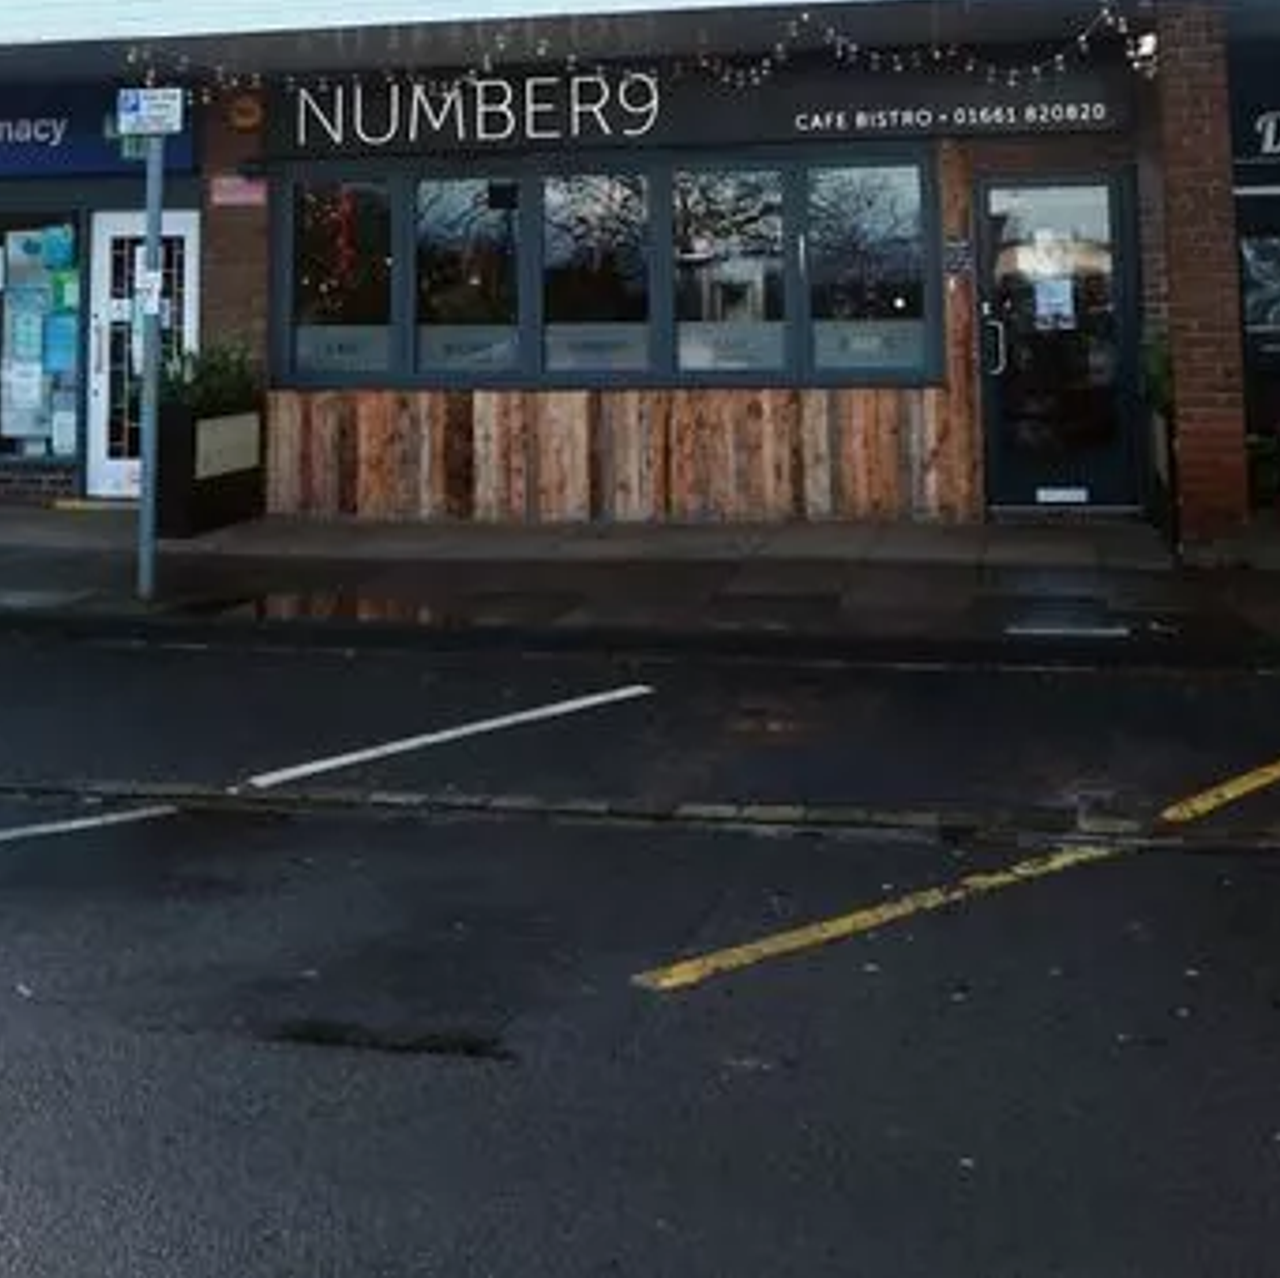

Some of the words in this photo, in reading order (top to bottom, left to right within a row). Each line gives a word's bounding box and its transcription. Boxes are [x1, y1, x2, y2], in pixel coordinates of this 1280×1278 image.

[299, 73, 660, 146] NUMBER9
[794, 112, 847, 131] CAFE
[855, 109, 933, 129] BISTRO
[953, 106, 1017, 124] 01661
[1025, 103, 1106, 123] 820820
